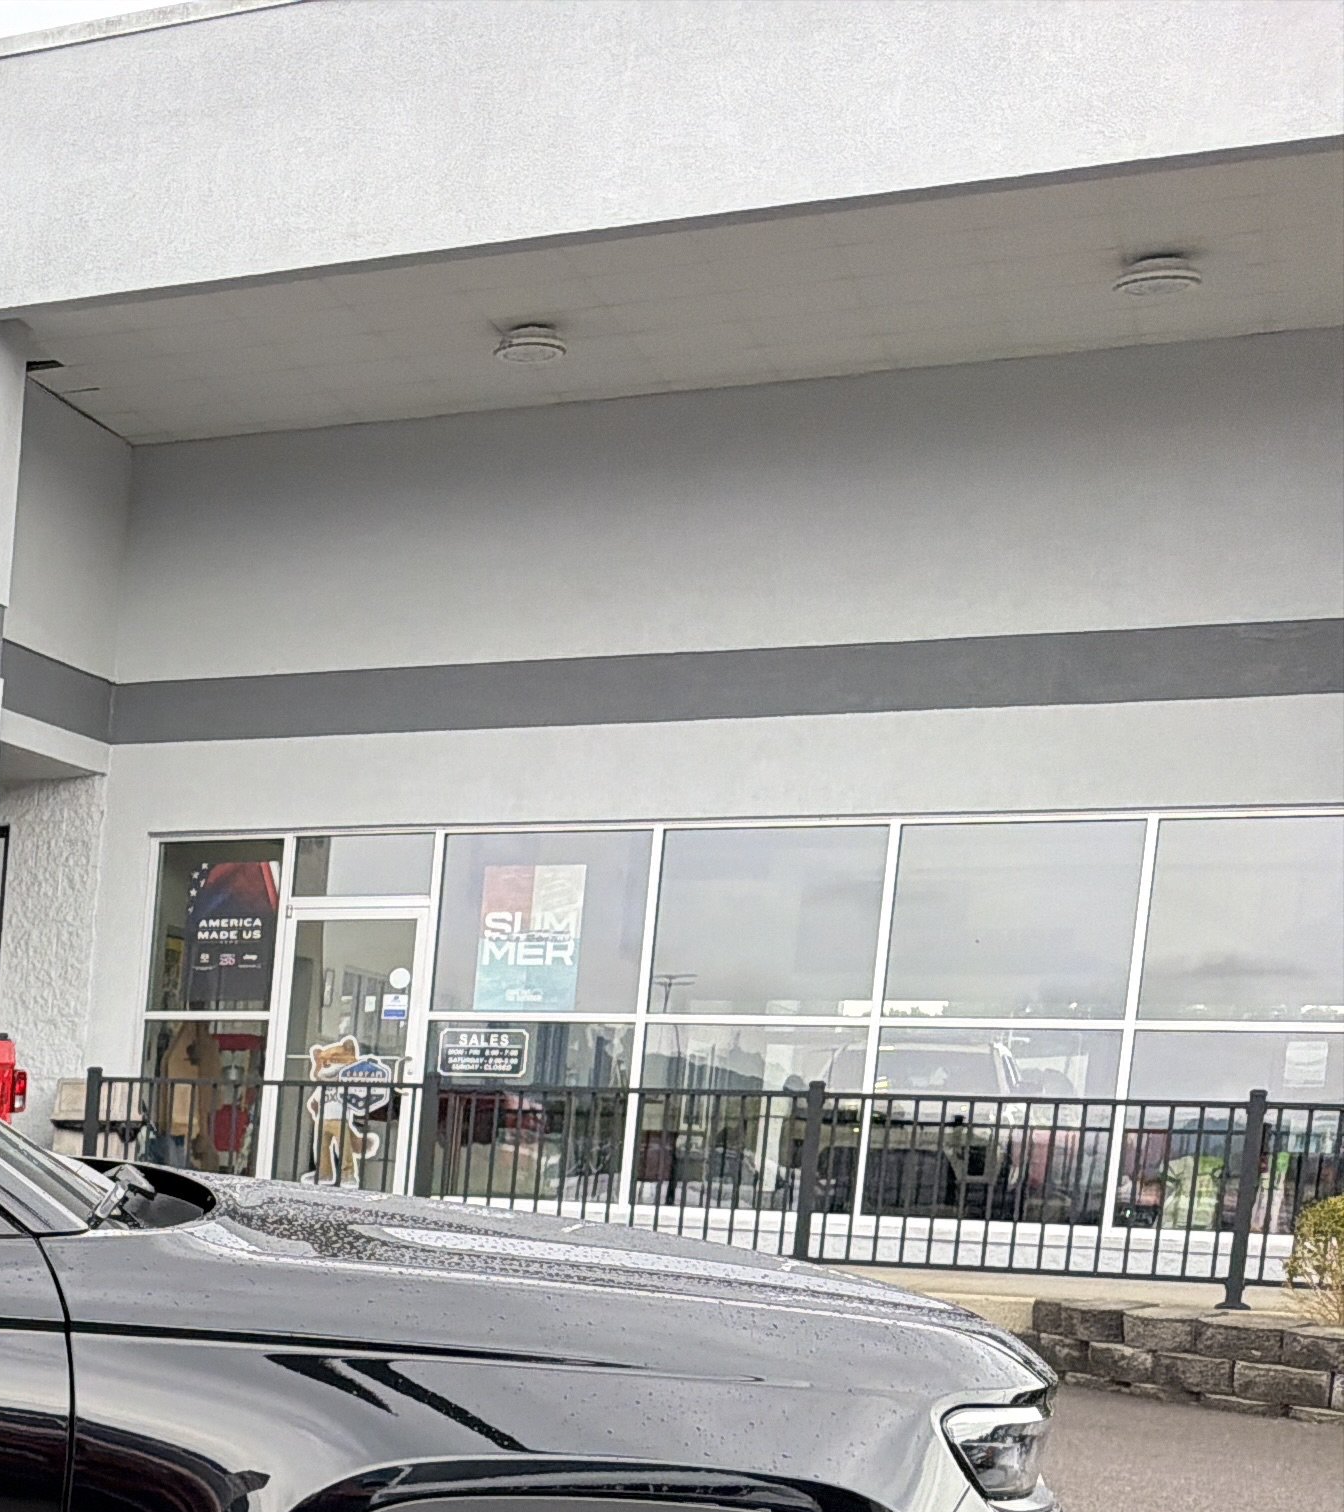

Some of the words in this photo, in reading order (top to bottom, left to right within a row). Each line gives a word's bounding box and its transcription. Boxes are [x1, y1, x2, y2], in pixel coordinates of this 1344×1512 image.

[199, 918, 262, 928] AMERICA
[197, 930, 238, 940] MADE
[242, 930, 262, 939] US
[481, 939, 575, 966] MER
[458, 1033, 509, 1047] SALES
